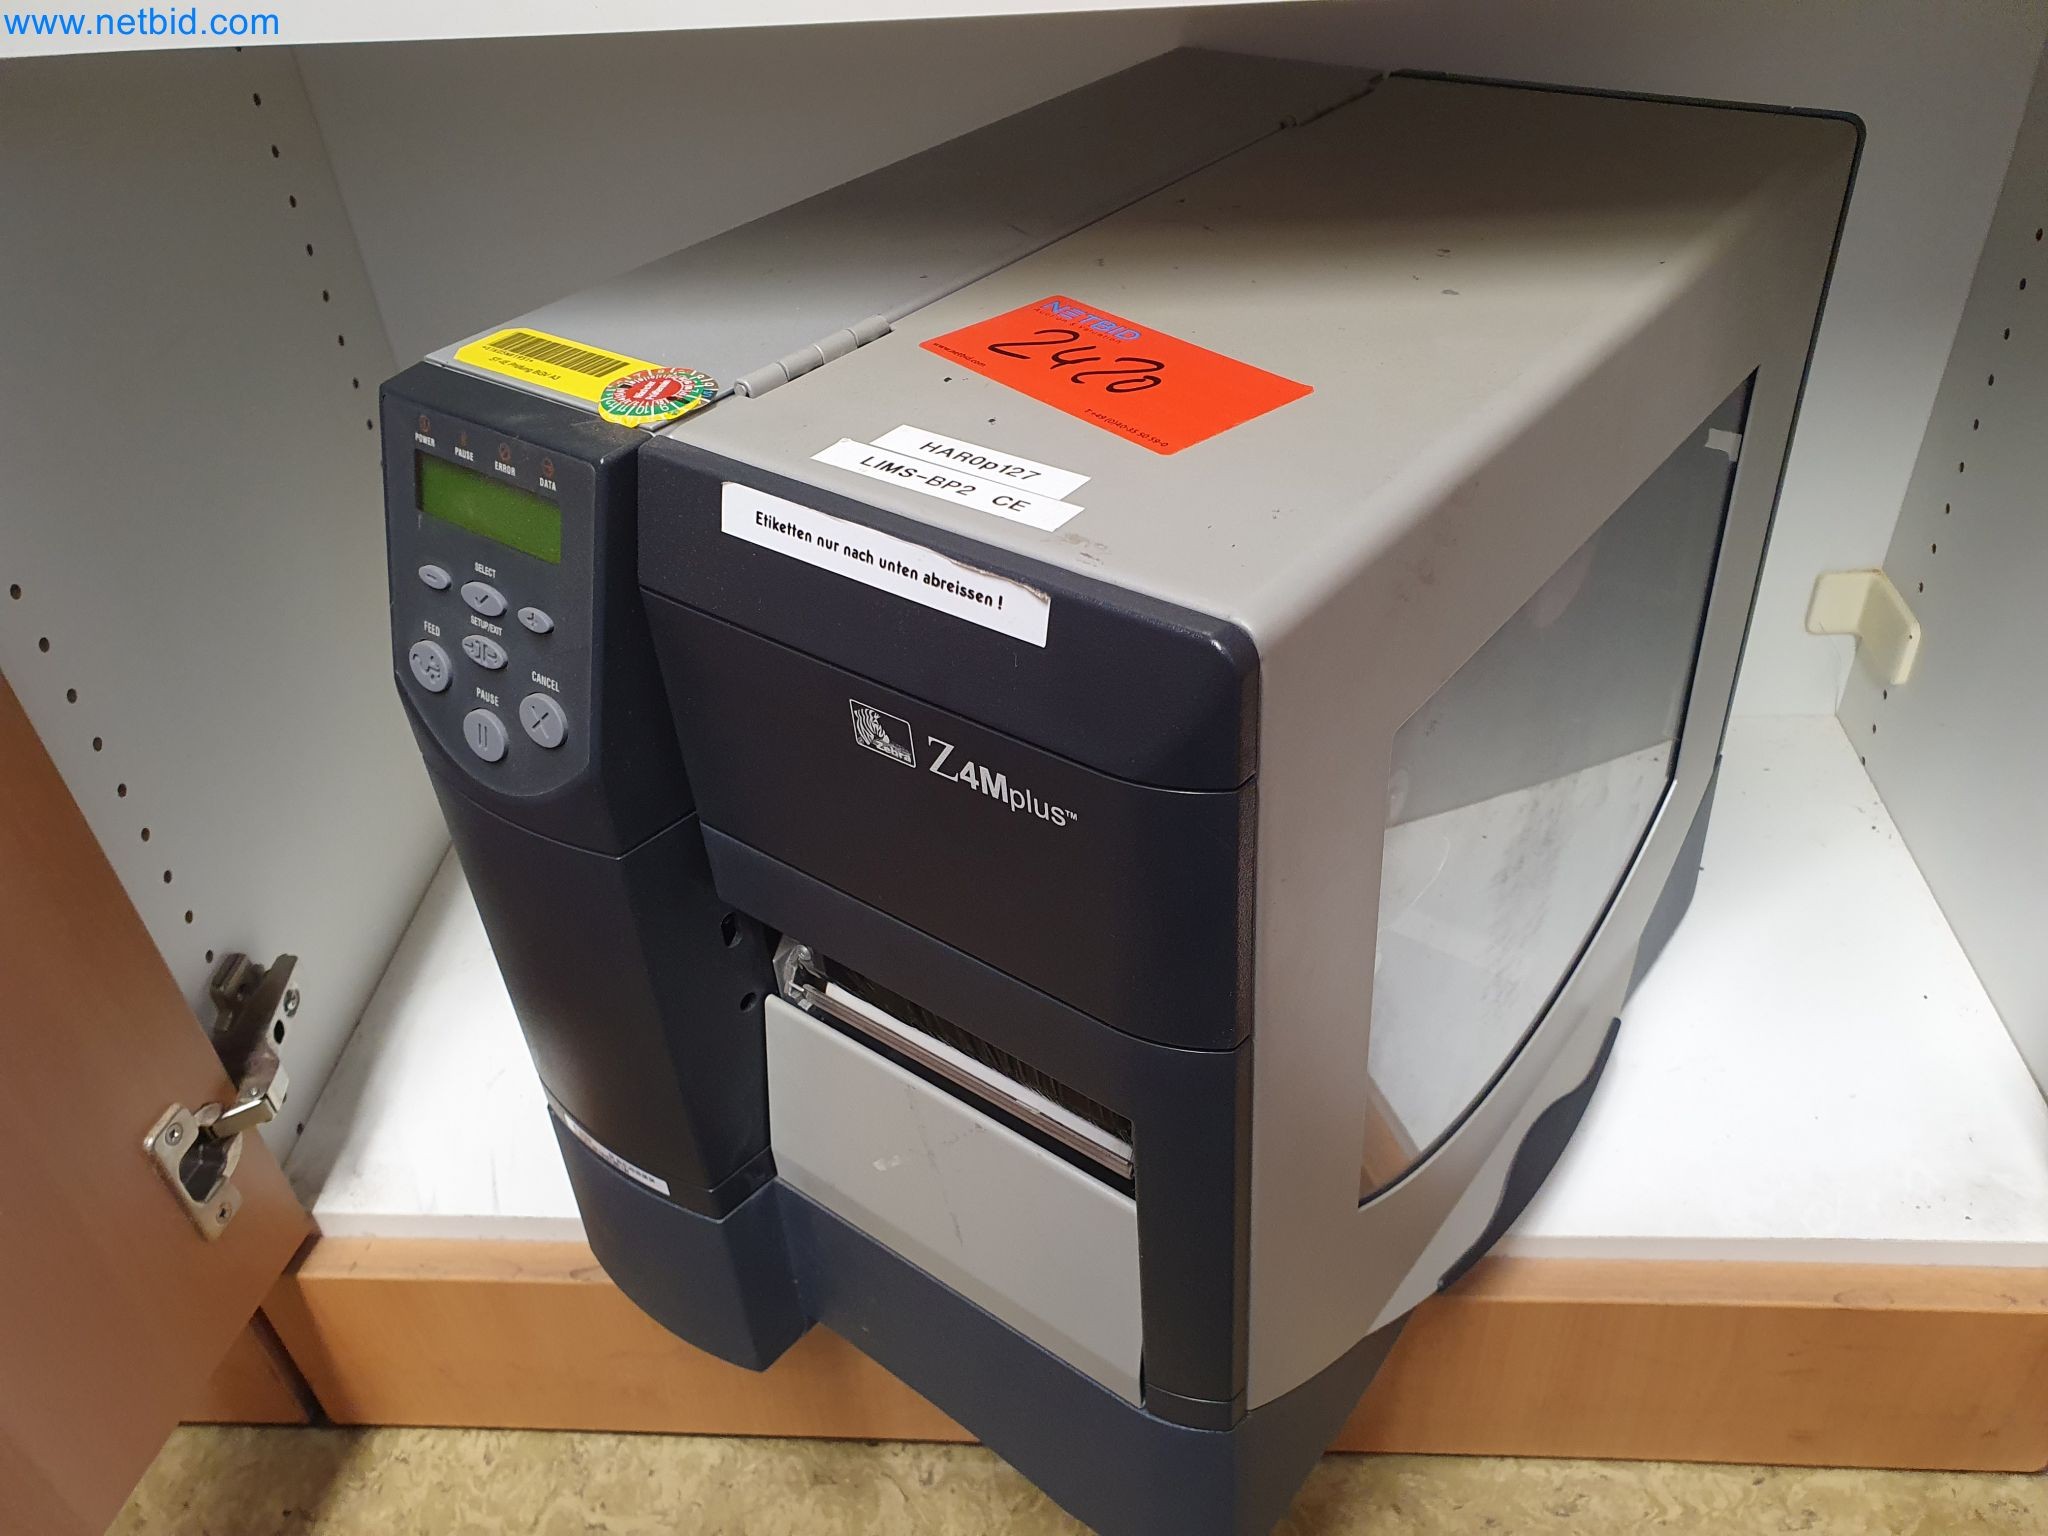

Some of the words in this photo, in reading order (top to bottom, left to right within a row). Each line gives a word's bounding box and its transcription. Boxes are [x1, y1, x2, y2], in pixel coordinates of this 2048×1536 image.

[1041, 300, 1142, 341] NETBID
[933, 342, 986, 367] www.netbid.com
[987, 328, 1165, 394] 2420
[415, 432, 436, 448] POWER
[454, 446, 474, 462] PAUSE
[494, 460, 516, 477] ERROR
[539, 477, 557, 492] DATA
[860, 456, 976, 496] LIMS-BP2
[991, 495, 1032, 513] CE
[755, 510, 812, 543] Etiketten
[817, 535, 839, 553] nur
[843, 545, 874, 565] nach
[879, 557, 918, 580] unten
[923, 572, 993, 607] abreissen
[474, 562, 497, 579] SELECT
[423, 620, 441, 637] FEED
[470, 615, 503, 636] SETUP/EXIT
[531, 671, 560, 693] CANCEL
[476, 687, 499, 707] PAUSE
[875, 740, 912, 763] Zebra
